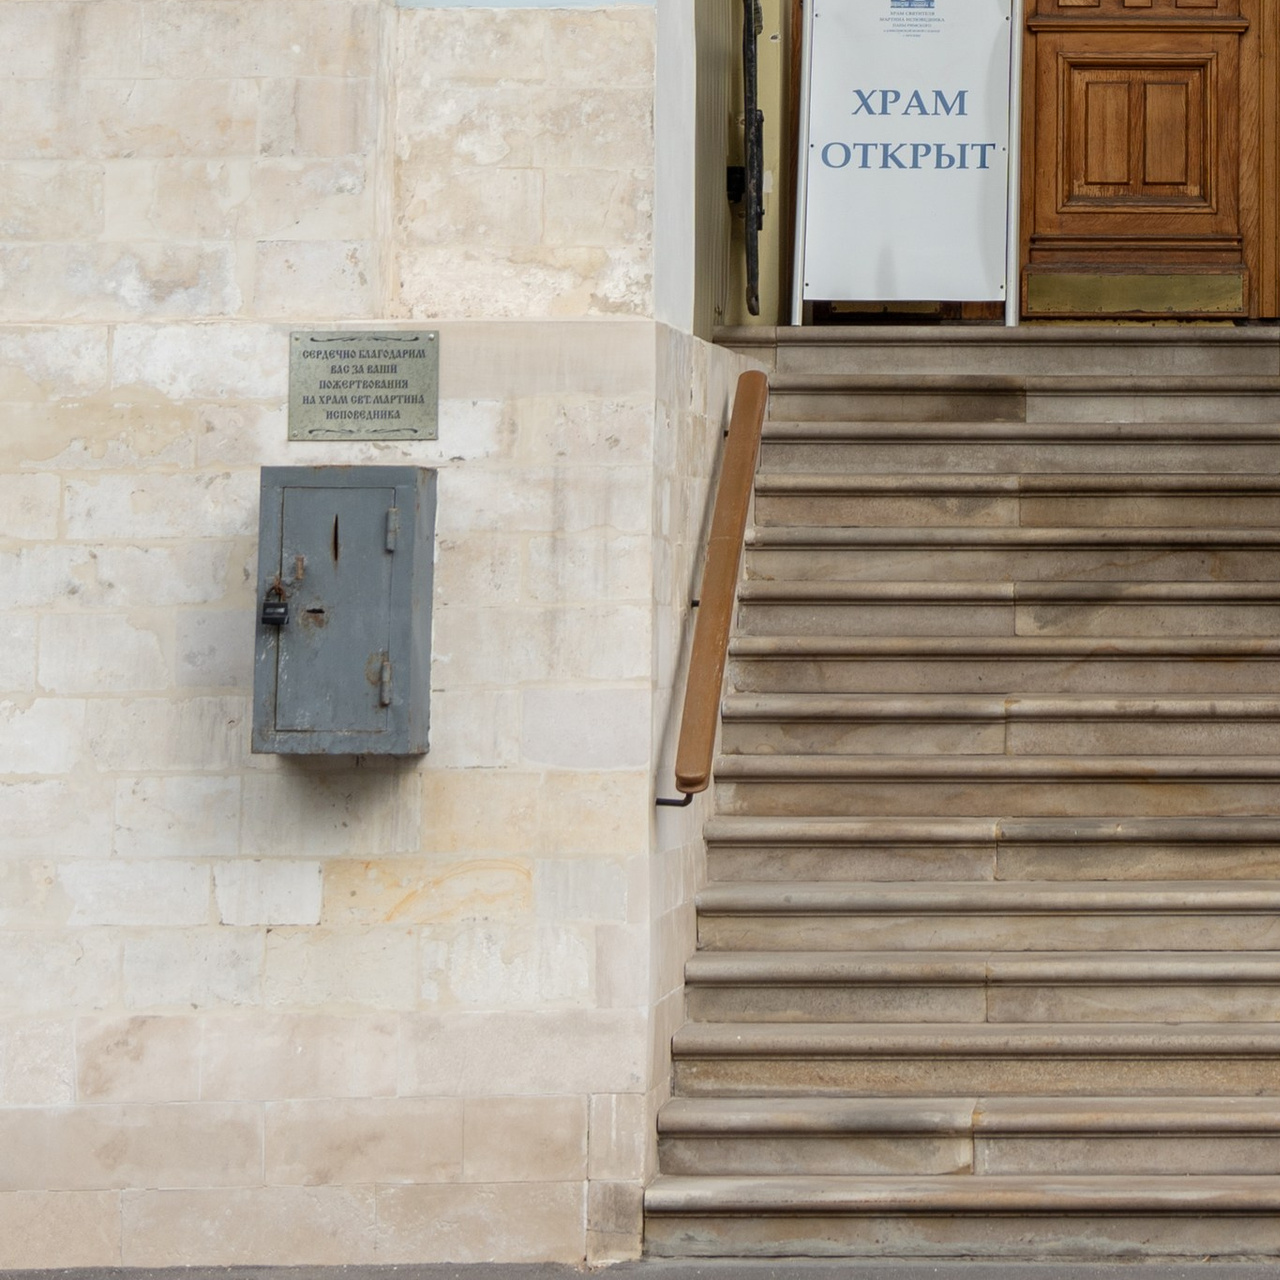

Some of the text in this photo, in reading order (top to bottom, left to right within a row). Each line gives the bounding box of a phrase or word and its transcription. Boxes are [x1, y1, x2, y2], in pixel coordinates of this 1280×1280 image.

[851, 89, 969, 116] ХРАМ
[821, 142, 996, 170] ОТКРЫТ
[302, 349, 426, 360] СЕРДЕЧНО БЛАГОДАРИМ
[330, 364, 398, 375] ВАС ЗА ВАШИ
[319, 379, 409, 390] ПОЖЕРТВОВАНИЯ
[302, 395, 316, 405] НА
[318, 395, 348, 405] ХРАМ
[325, 410, 401, 421] ИСПОВЕДНИКА
